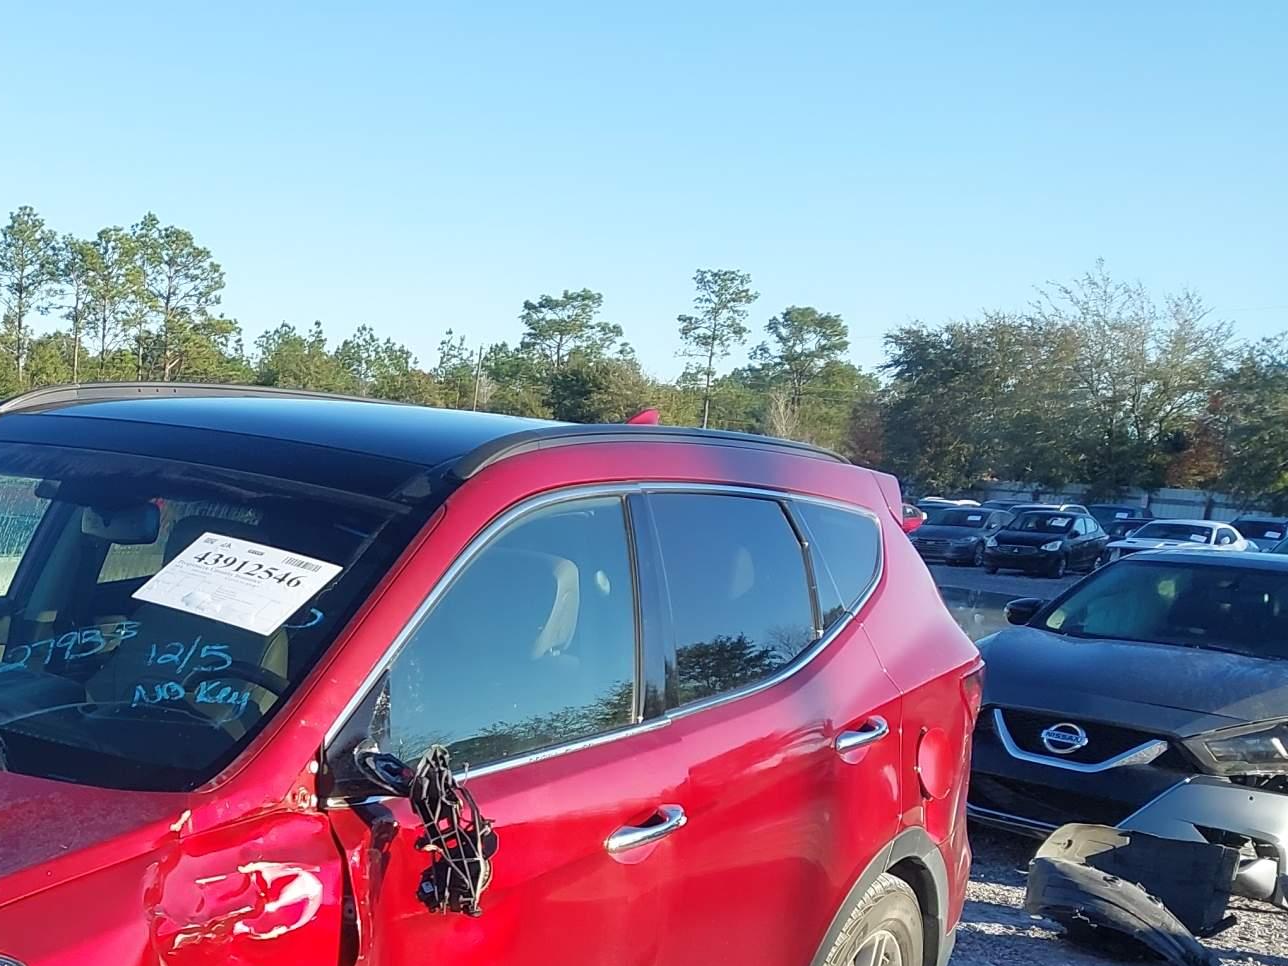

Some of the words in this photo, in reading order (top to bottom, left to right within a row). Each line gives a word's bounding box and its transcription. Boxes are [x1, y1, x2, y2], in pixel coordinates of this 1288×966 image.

[193, 551, 308, 588] 43912546
[146, 635, 232, 674] 12/5
[1045, 731, 1083, 744] NISSAN
